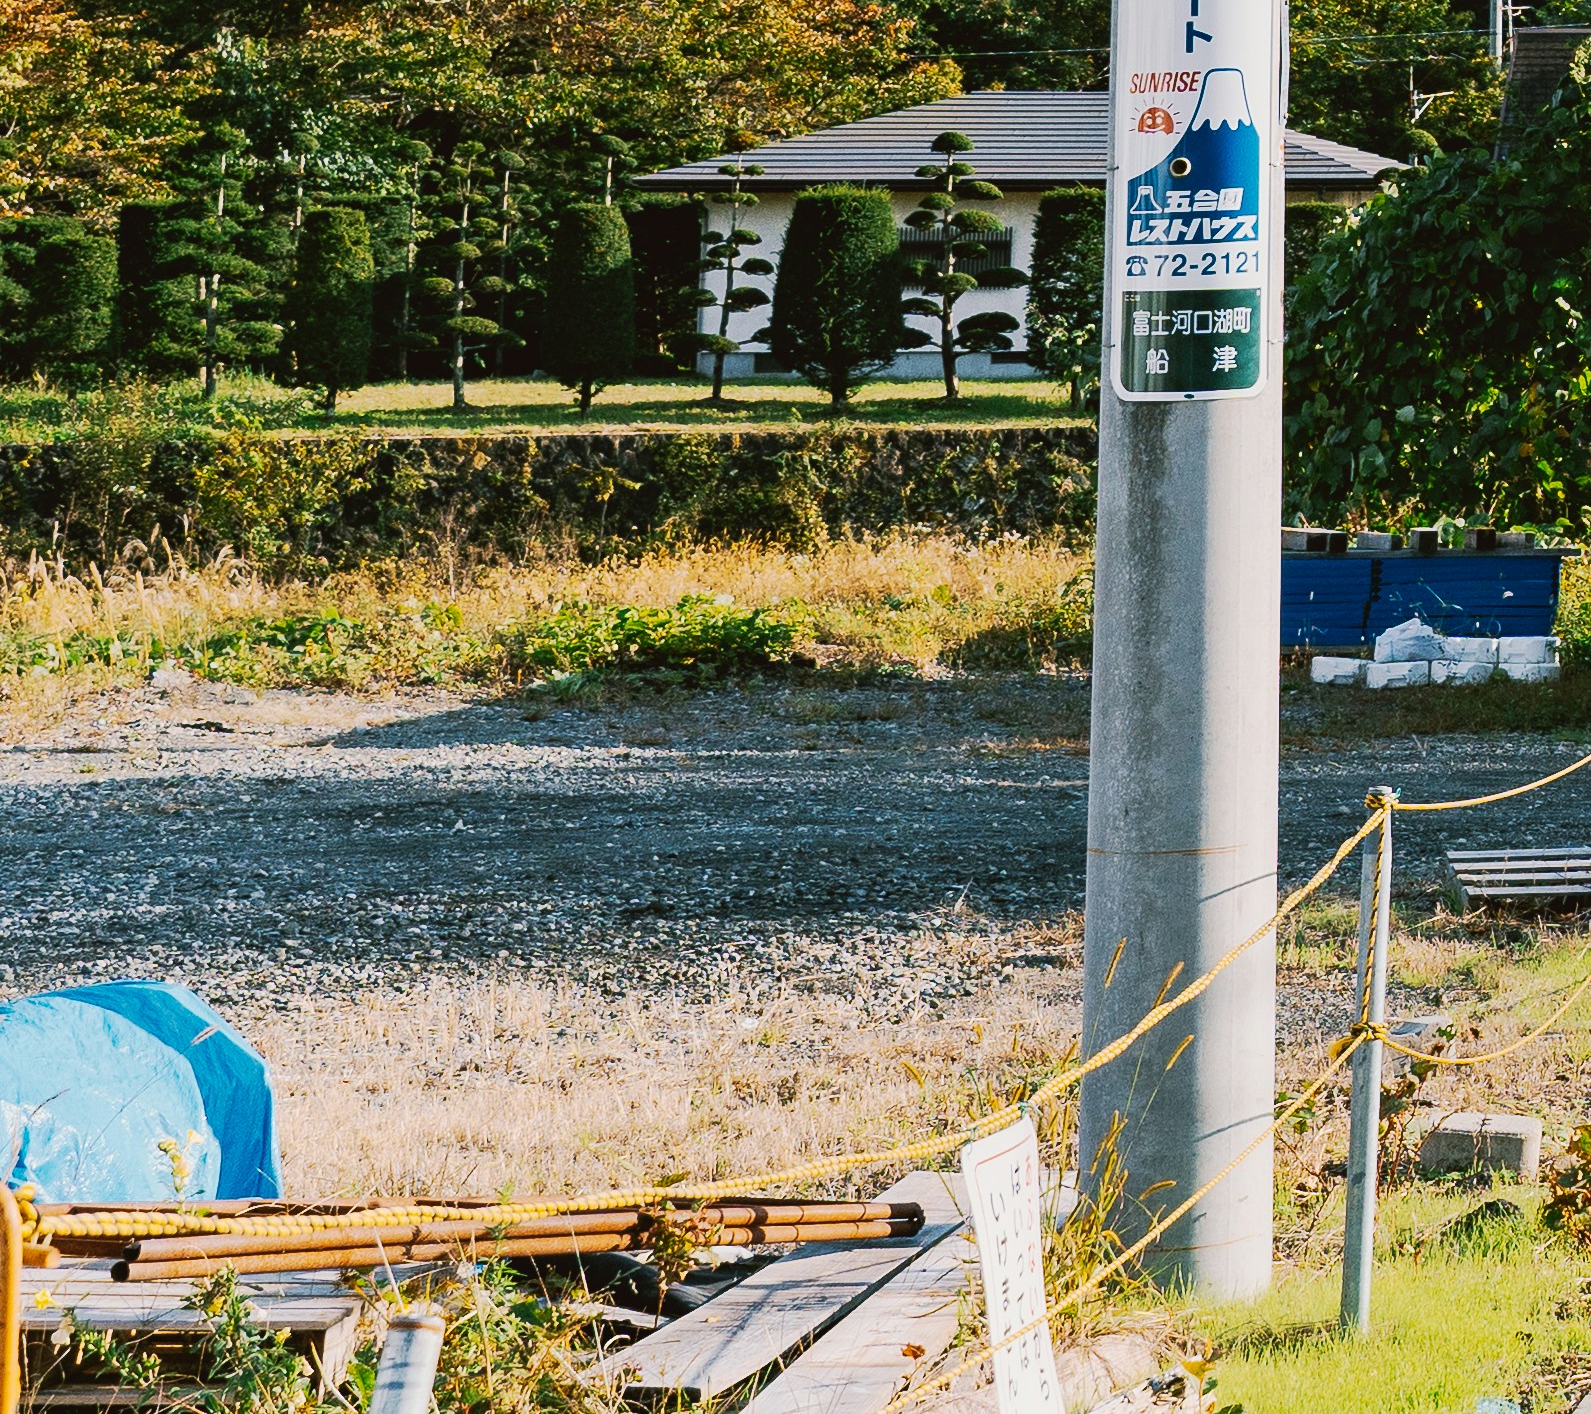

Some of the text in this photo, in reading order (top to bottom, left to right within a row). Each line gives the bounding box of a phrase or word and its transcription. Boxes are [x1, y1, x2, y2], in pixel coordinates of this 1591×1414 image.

[1129, 71, 1201, 94] SUNRISE
[1130, 215, 1258, 243] レストハウス
[1155, 250, 1259, 276] 72-2121
[1133, 306, 1252, 336] 富士河口湖町
